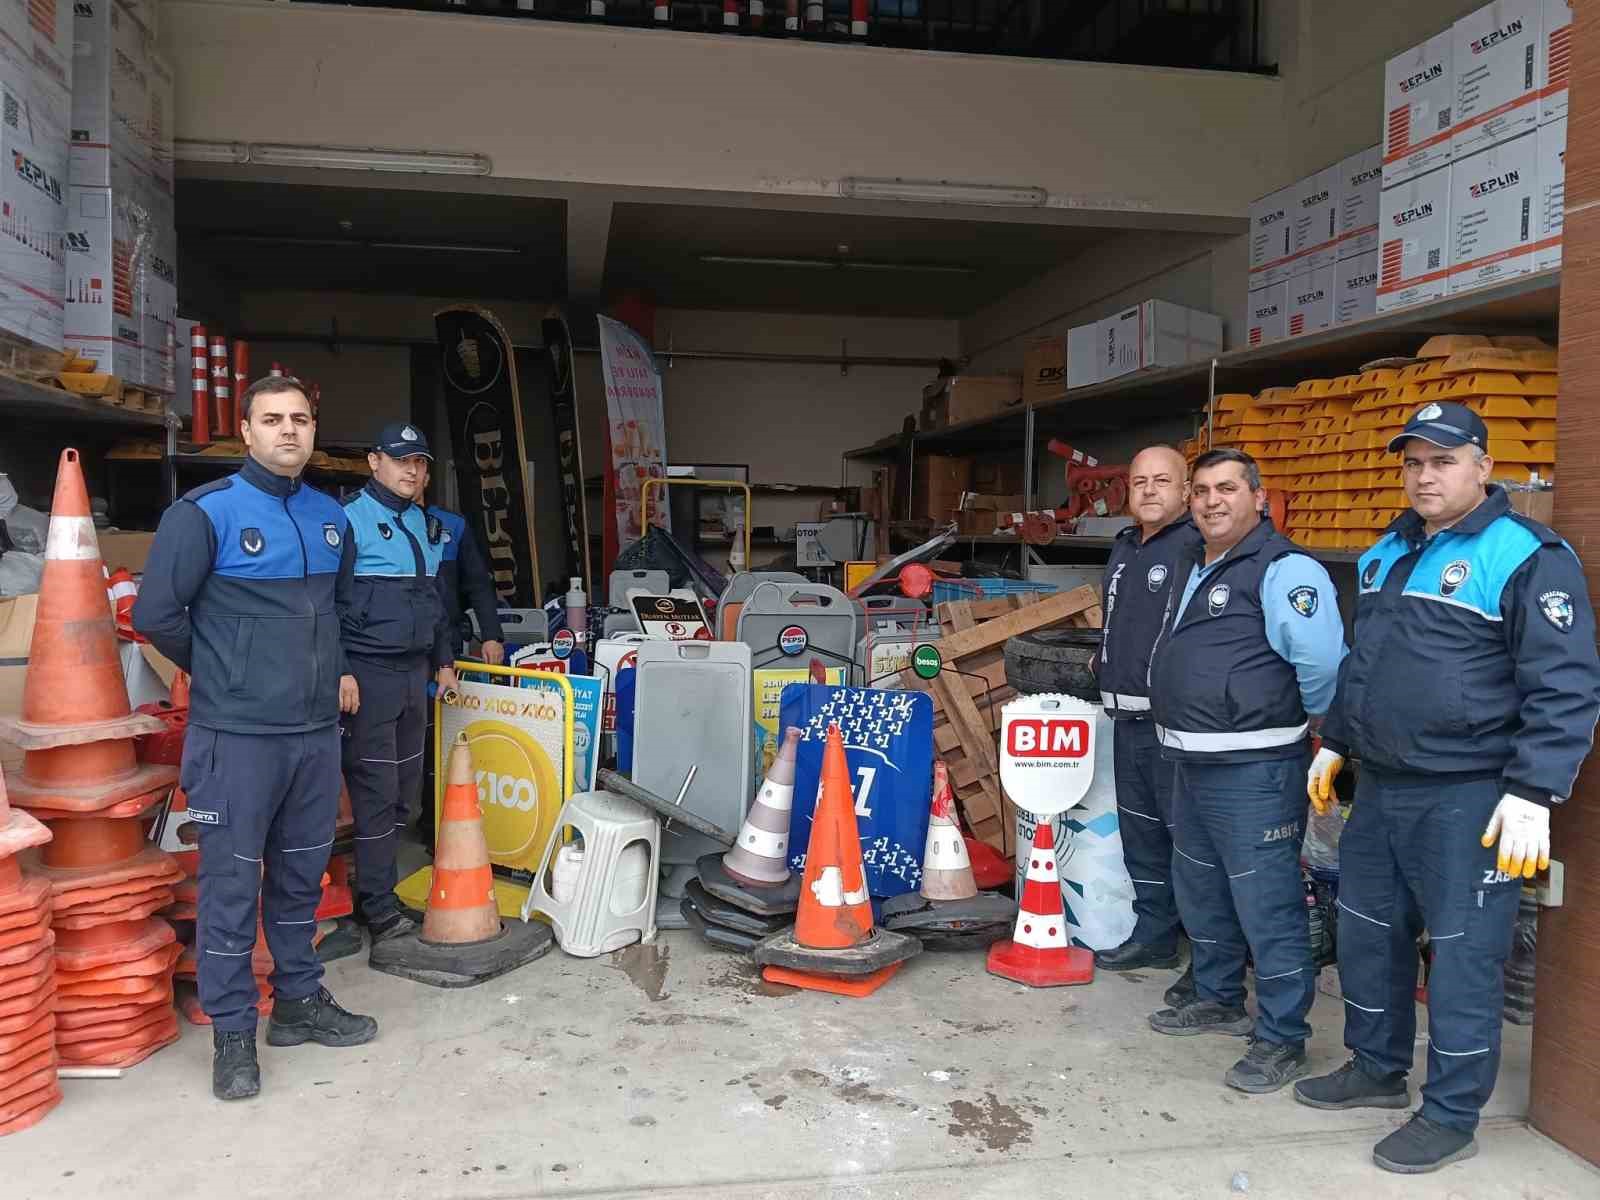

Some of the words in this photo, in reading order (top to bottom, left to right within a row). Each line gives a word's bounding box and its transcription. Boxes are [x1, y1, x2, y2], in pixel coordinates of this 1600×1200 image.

[1470, 20, 1523, 54] ZEPLIN
[1400, 63, 1443, 92] ZEPLIN
[1469, 170, 1520, 198] ZEPLIN
[1393, 202, 1433, 226] ZEPLIN
[782, 636, 805, 644] PEPSI
[832, 689, 846, 704] +1
[851, 691, 865, 705] +1
[871, 692, 885, 707] +1
[821, 702, 835, 716] +1
[840, 704, 854, 718] +1
[859, 705, 873, 719] +1
[879, 706, 894, 721] +1
[809, 715, 824, 729] +1
[848, 717, 863, 731] +1
[867, 720, 882, 734] +1
[887, 721, 903, 735] +1
[855, 732, 869, 746] +1
[874, 734, 889, 748] +1
[1014, 760, 1080, 769] www.bim.com.tr
[873, 837, 889, 852] +1
[882, 851, 897, 866] +1
